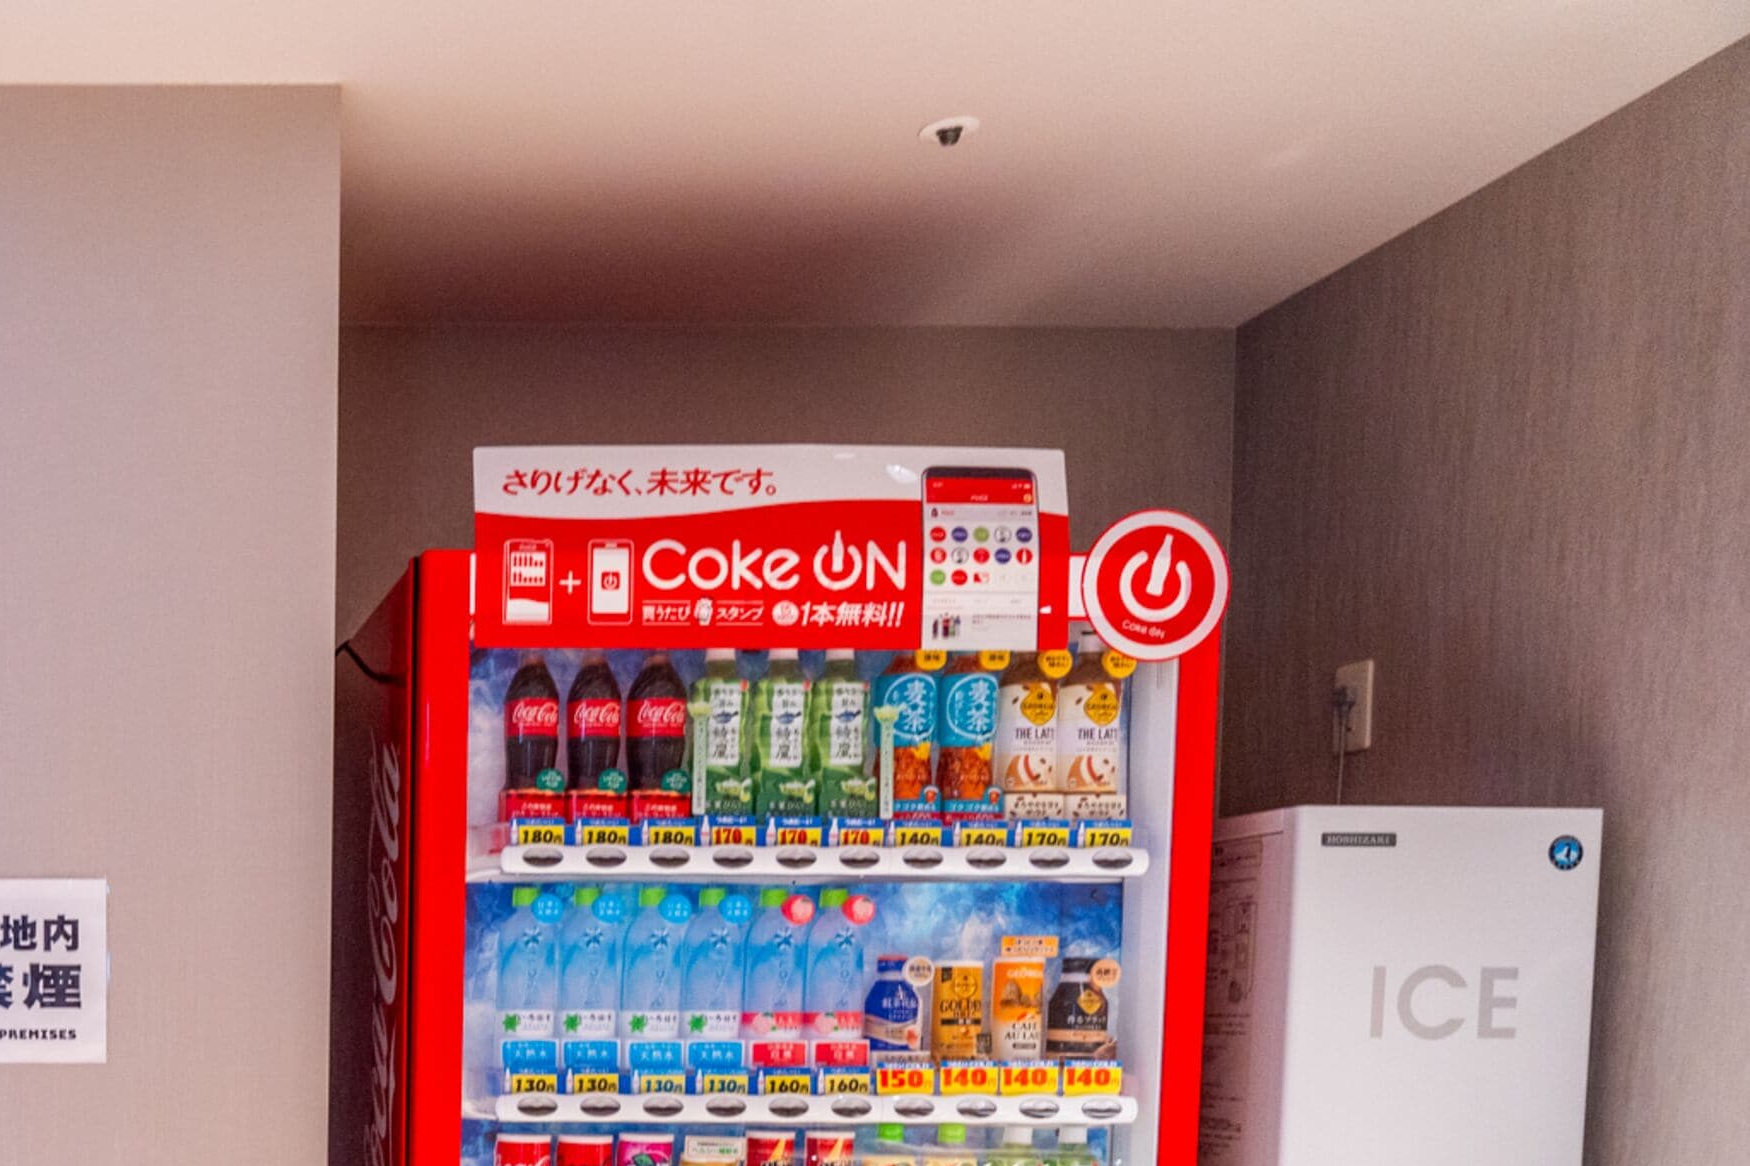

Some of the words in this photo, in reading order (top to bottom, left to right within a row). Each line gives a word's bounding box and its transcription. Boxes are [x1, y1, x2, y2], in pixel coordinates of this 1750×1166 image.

[502, 468, 777, 496] さりげなく、未来です。
[642, 539, 800, 590] Coke
[813, 530, 907, 590] ON
[716, 605, 764, 620] スタンプ
[906, 680, 927, 733] 麦茶
[967, 680, 989, 733] 麦茶
[1370, 964, 1519, 1041] ICE
